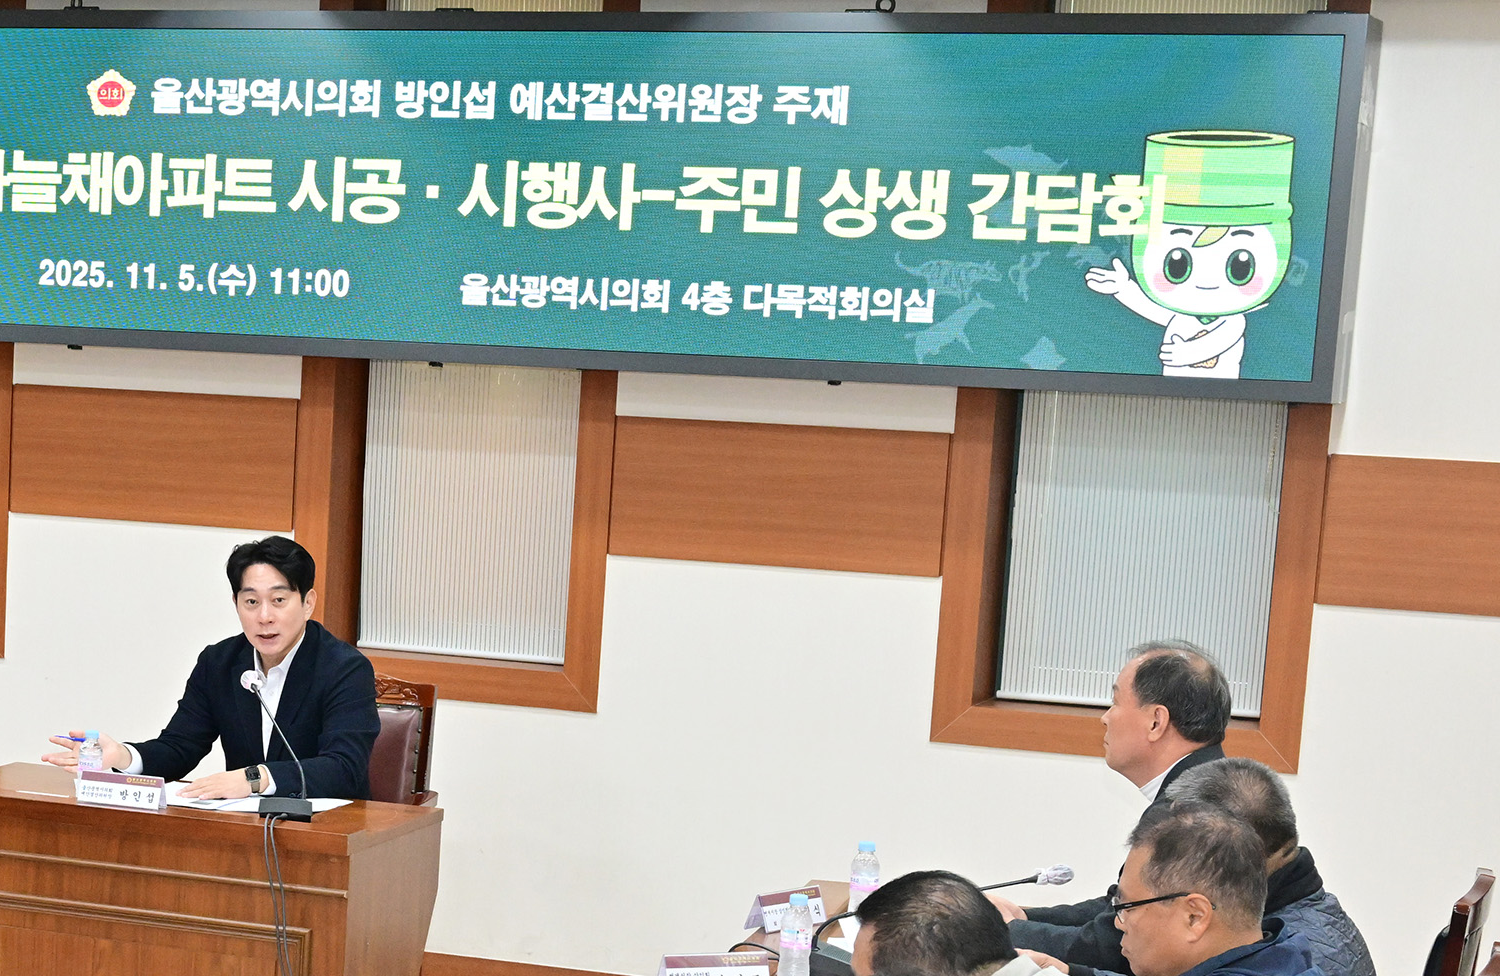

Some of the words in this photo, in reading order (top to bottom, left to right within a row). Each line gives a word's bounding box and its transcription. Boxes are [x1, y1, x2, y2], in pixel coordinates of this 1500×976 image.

[98, 87, 123, 100] 의회
[151, 78, 381, 117] 울산광역시의회
[395, 81, 496, 119] 방인섭
[509, 82, 763, 124] 예산결산위원장
[773, 85, 850, 126] 주재
[287, 157, 407, 224] 시공
[457, 161, 802, 235] 시행사-주민
[819, 169, 951, 241] 상생
[968, 171, 1168, 246] 간담회
[38, 258, 114, 288] 2025.
[126, 262, 167, 290] 11.
[178, 262, 257, 297] 5.(수)
[270, 267, 350, 298] 11:00
[459, 273, 671, 314] 울산광역시의회
[681, 280, 733, 316] 4층
[743, 284, 936, 324] 다목적회의실
